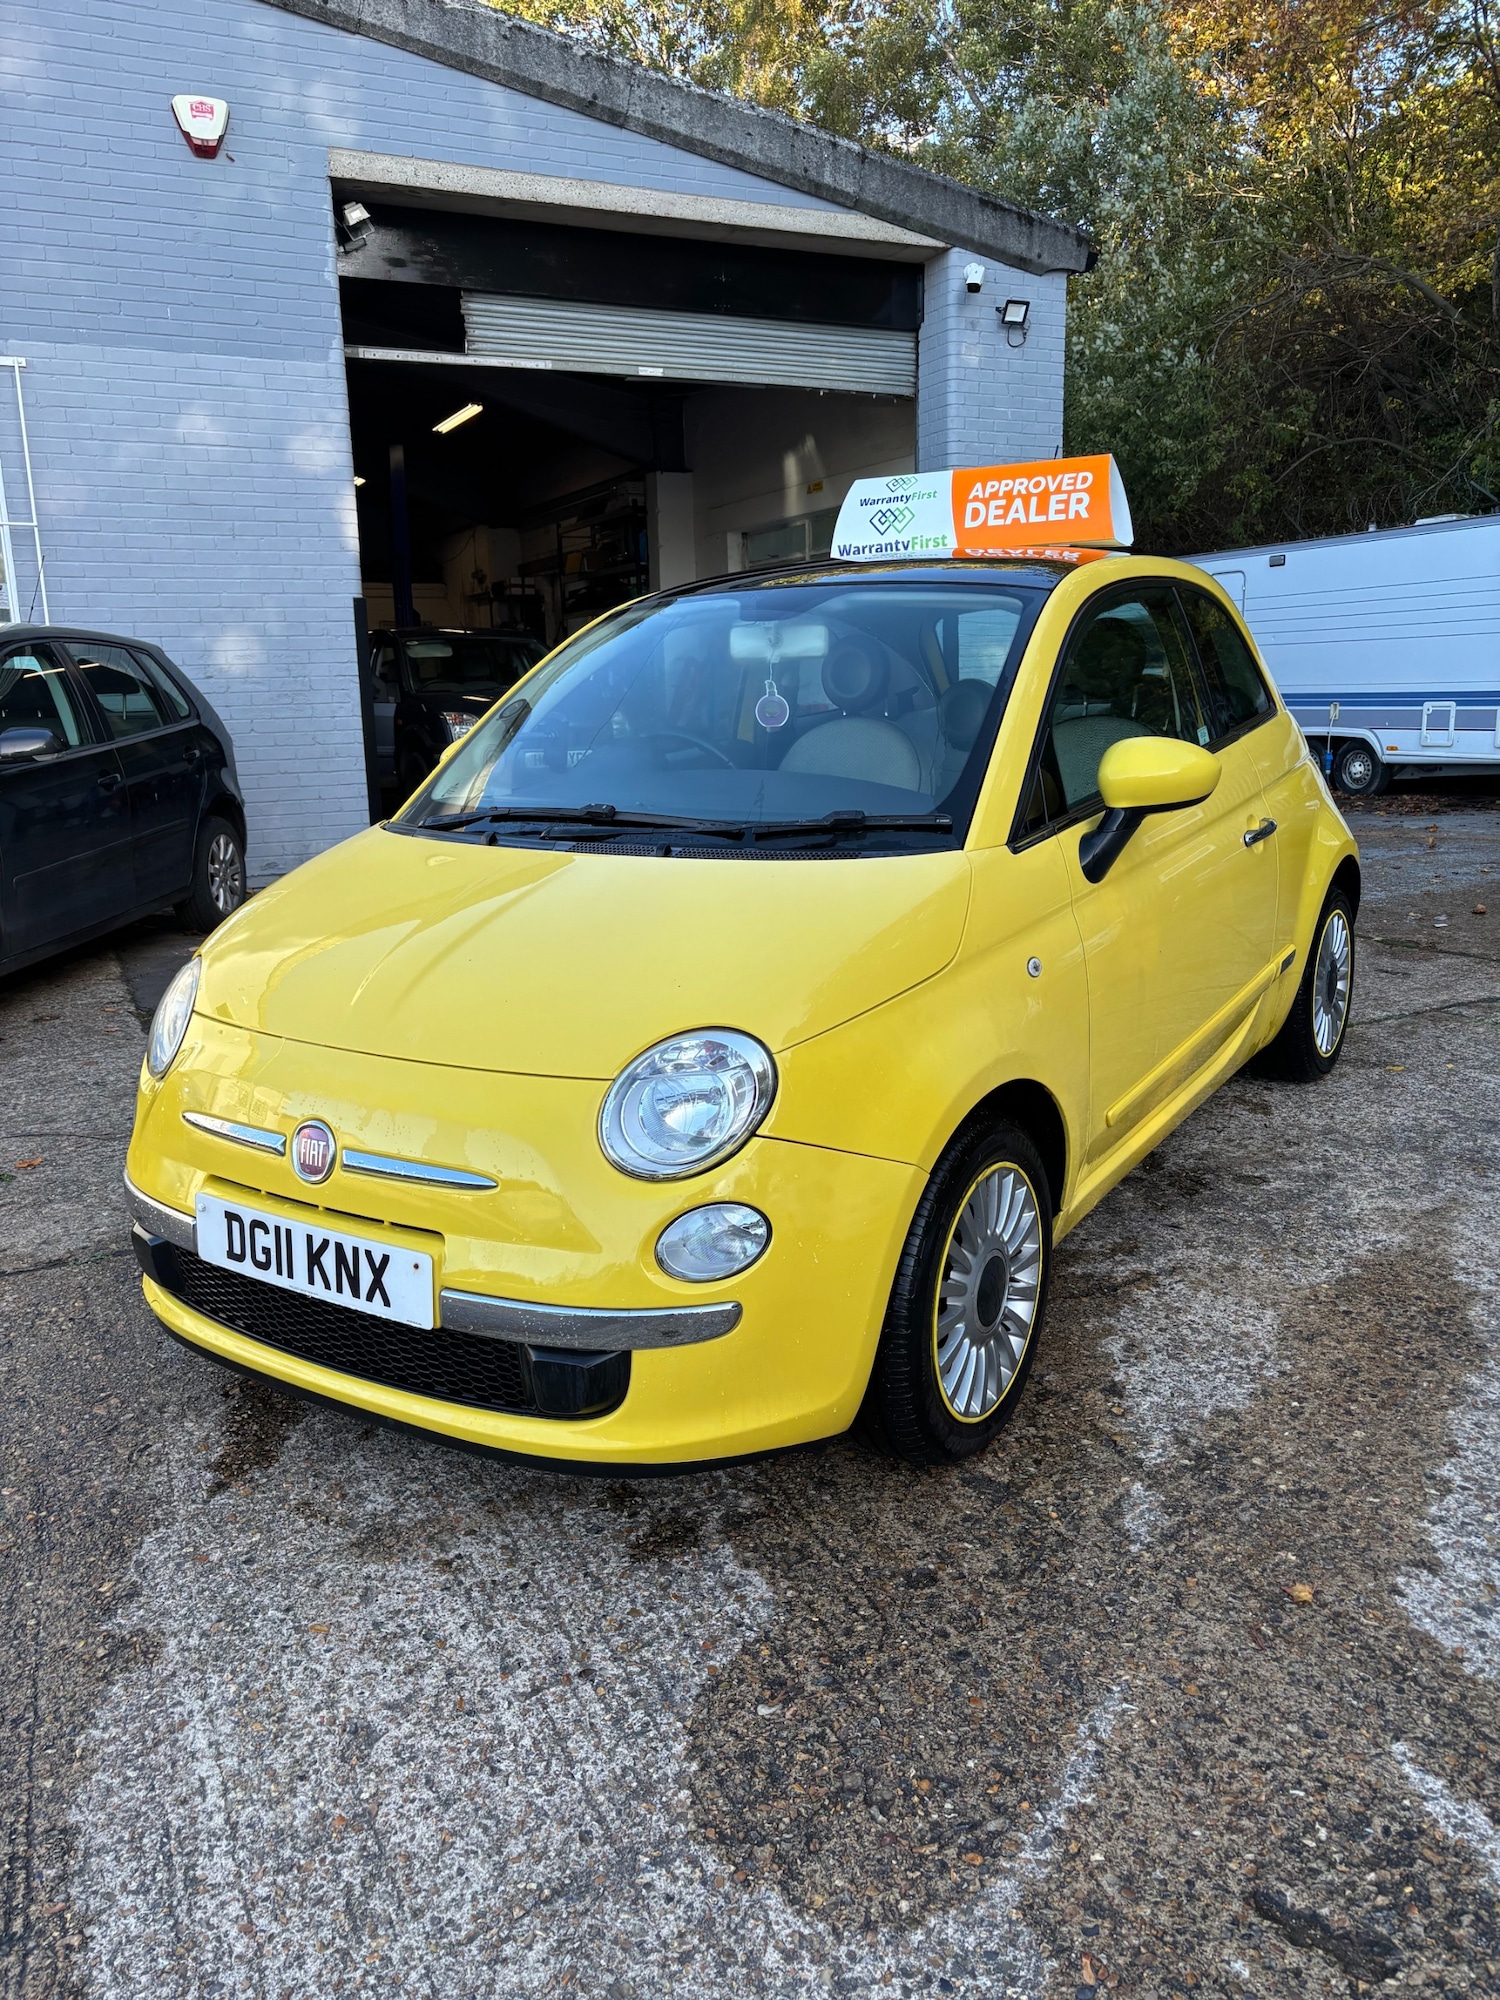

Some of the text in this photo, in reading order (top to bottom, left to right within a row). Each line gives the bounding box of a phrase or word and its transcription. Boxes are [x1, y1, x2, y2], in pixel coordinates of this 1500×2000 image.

[859, 490, 938, 507] WarrantyFirst
[968, 471, 1093, 500] APPROVED
[964, 492, 1090, 529] DEALER
[300, 1137, 327, 1168] FIAT
[224, 1210, 391, 1308] DG11 KNX
